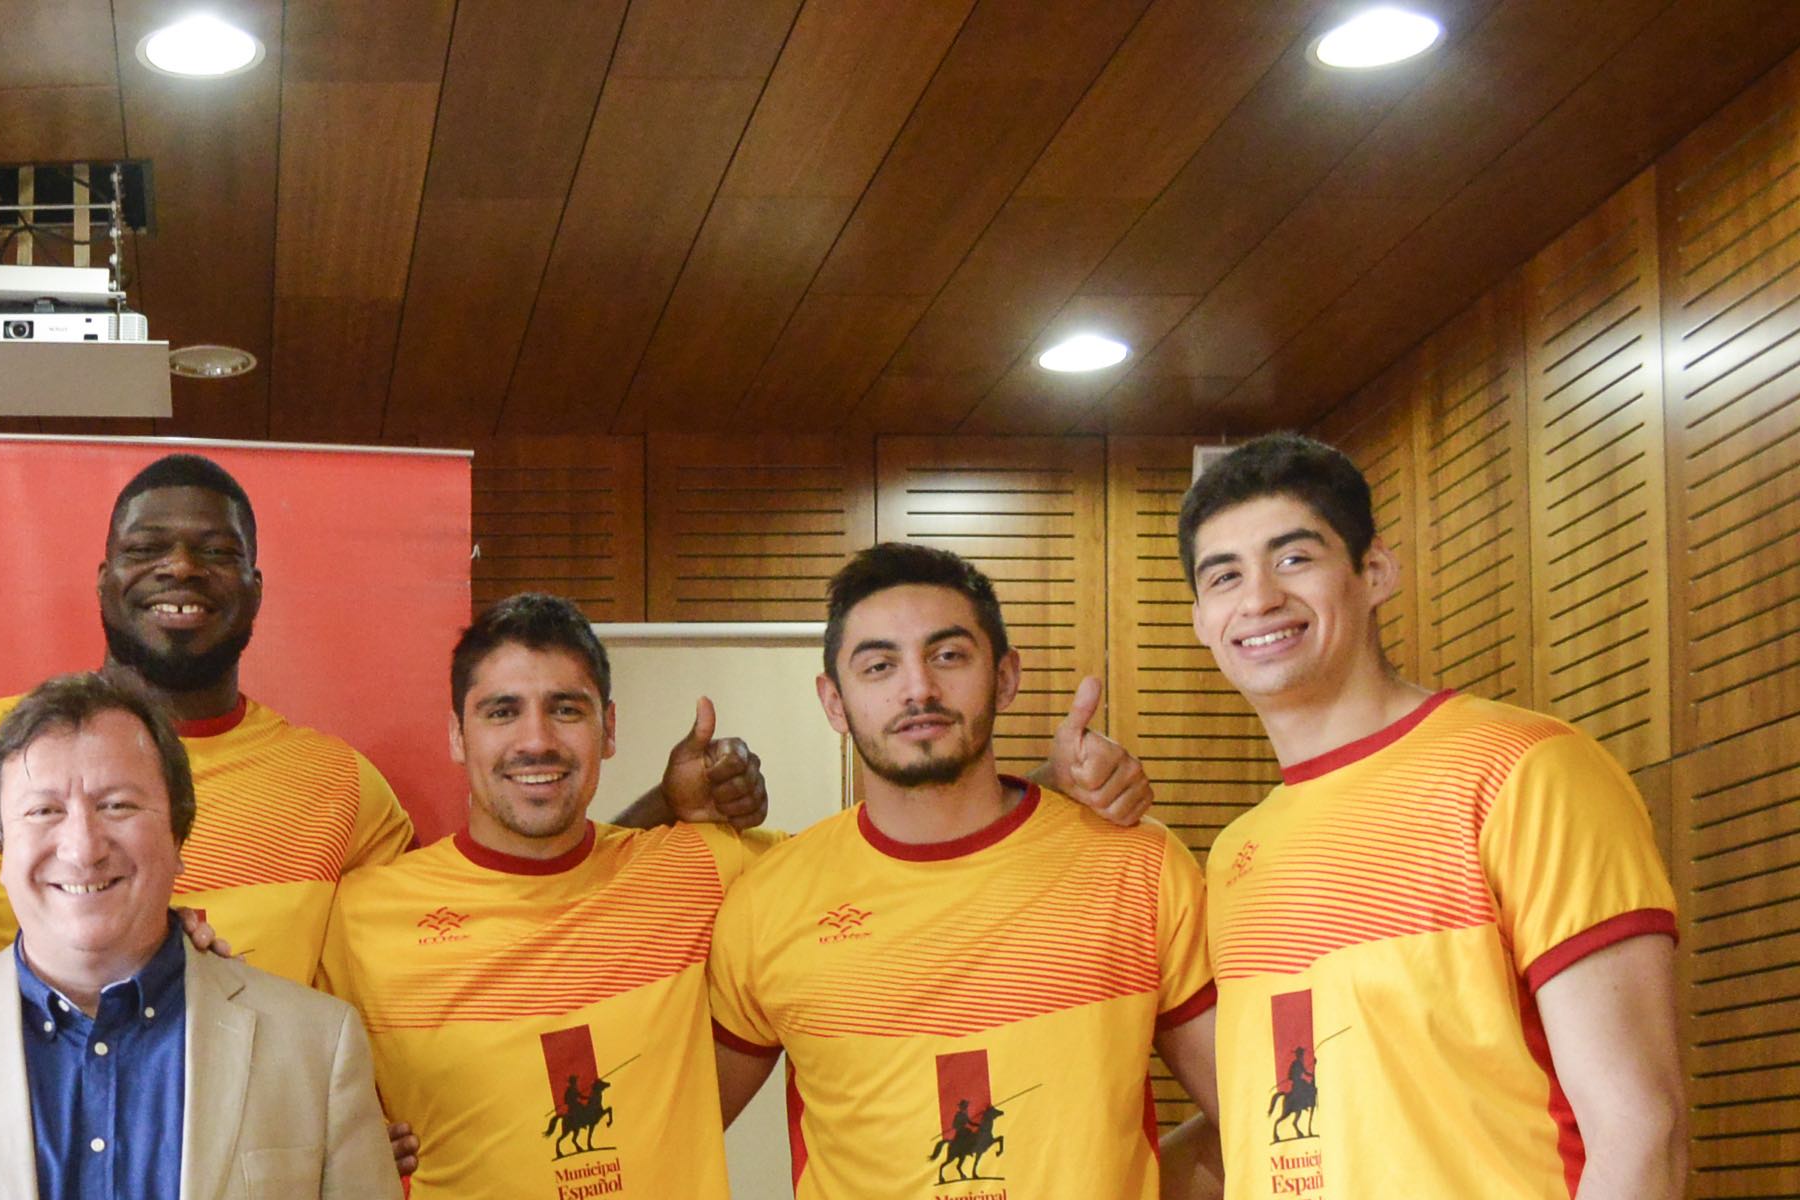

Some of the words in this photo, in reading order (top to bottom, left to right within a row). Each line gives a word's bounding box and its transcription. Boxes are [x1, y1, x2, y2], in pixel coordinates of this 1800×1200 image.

[554, 1157, 622, 1183] Municipal
[1270, 1149, 1323, 1172] Munici
[1271, 1169, 1325, 1196] Españ
